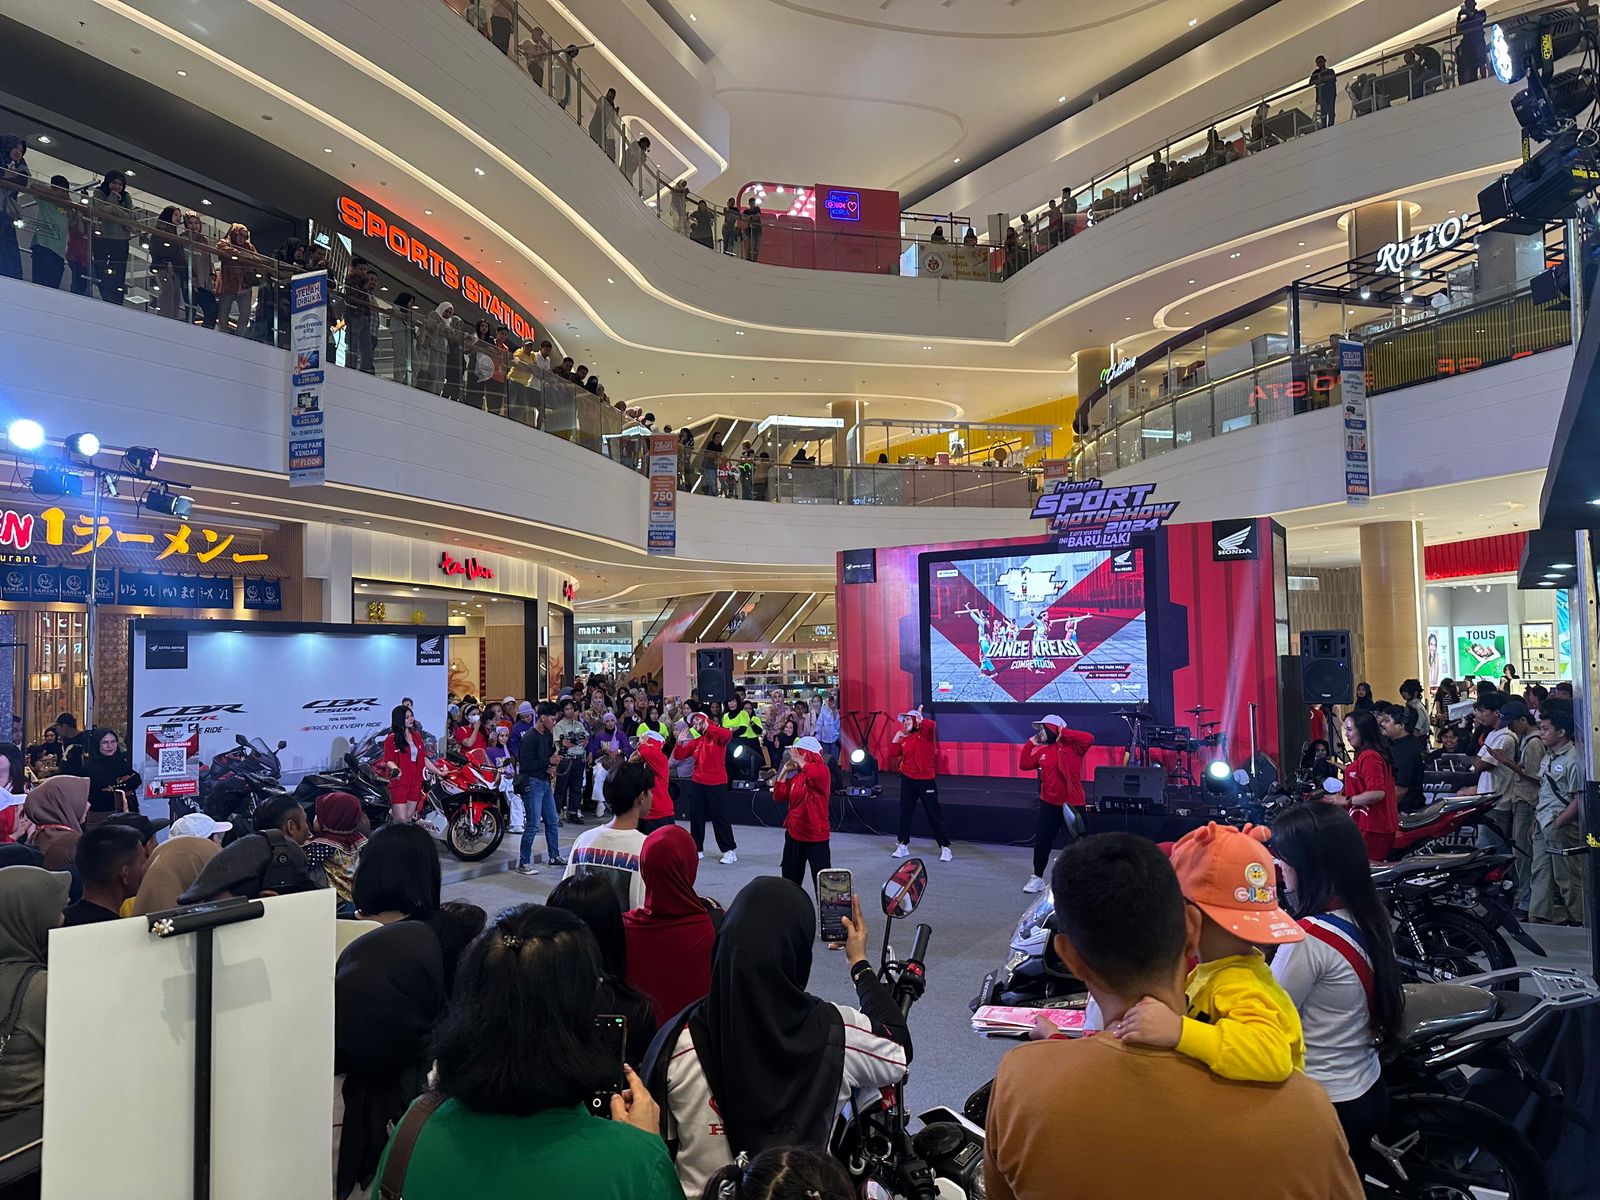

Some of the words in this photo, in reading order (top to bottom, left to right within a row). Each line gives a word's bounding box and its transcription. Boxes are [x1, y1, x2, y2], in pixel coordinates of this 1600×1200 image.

[337, 195, 460, 290] SPORTS
[462, 273, 536, 342] STATION
[297, 284, 320, 297] TELAH
[297, 294, 321, 306] DIBUKA
[308, 441, 322, 450] PARK
[295, 449, 319, 457] KENDARI
[301, 458, 320, 466] FLOOR
[1056, 479, 1100, 493] Honda
[652, 491, 673, 501] 750
[1032, 484, 1153, 516] SPORT
[1053, 503, 1174, 528] MOTOSHOW
[1104, 518, 1159, 534] 2024
[1067, 535, 1099, 548] BARU
[1102, 532, 1131, 545] LAKI
[1217, 548, 1253, 556] HONDA
[1466, 630, 1496, 640] TOUS
[986, 640, 1029, 657] DANCE
[1031, 639, 1082, 657] KREASI
[1010, 659, 1056, 670] COMPETITION
[302, 697, 382, 709] CBR
[140, 703, 248, 718] CBR
[314, 706, 371, 714] 250RR
[166, 715, 220, 723] 150R
[204, 726, 222, 734] RIDE
[339, 722, 366, 730] EVERY
